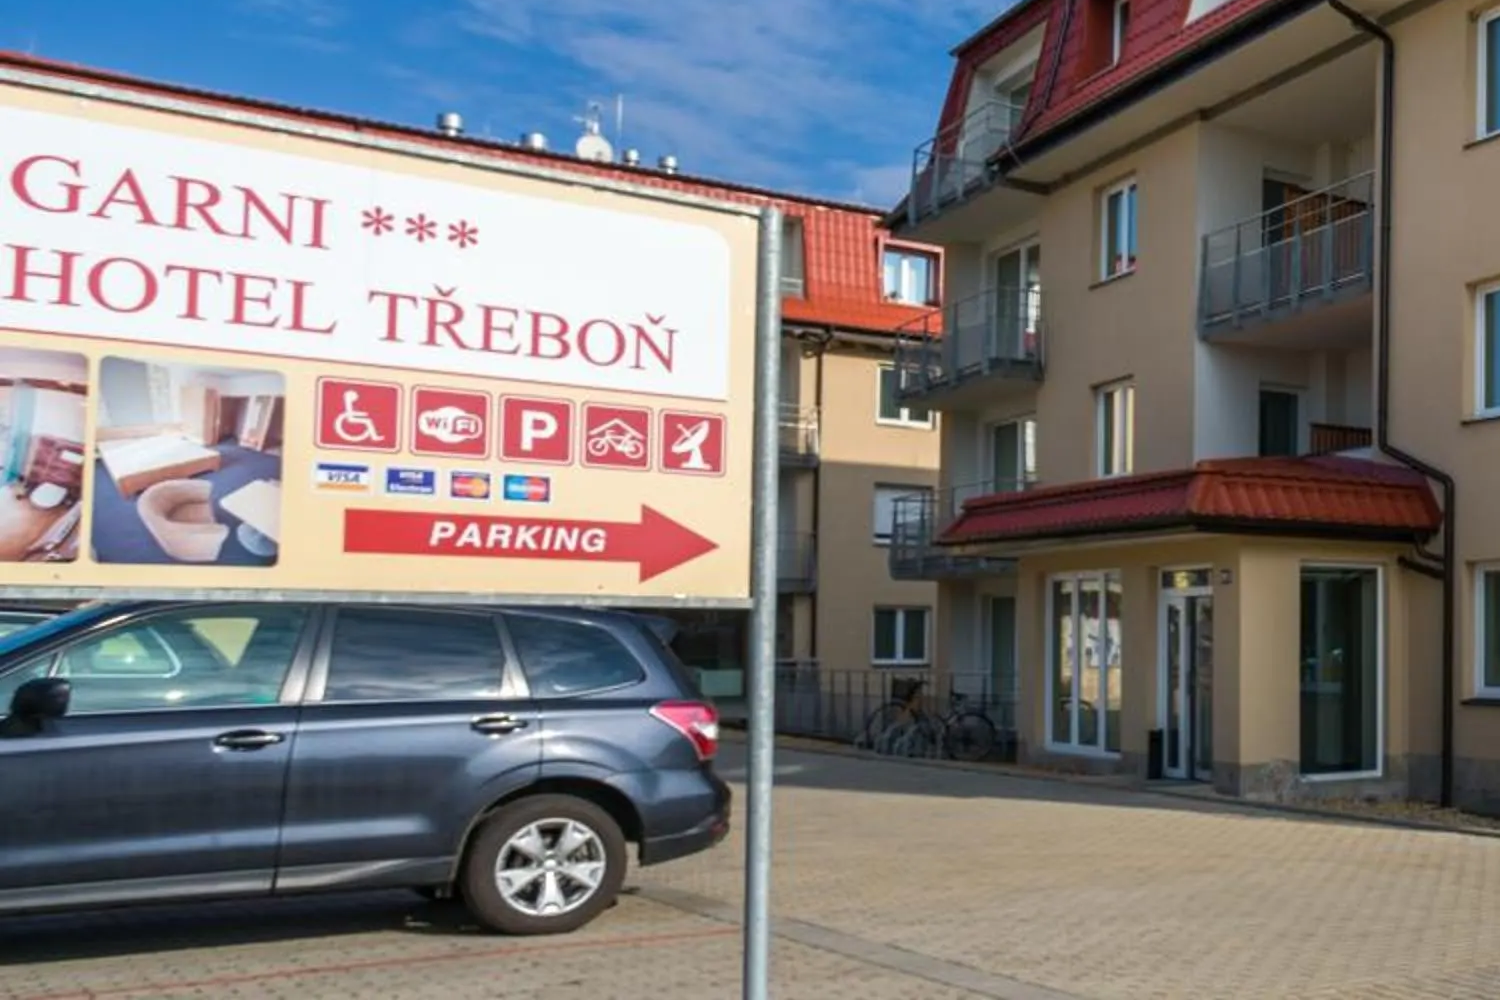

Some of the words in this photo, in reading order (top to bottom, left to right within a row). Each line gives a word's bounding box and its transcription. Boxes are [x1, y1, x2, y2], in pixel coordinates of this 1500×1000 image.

[10, 155, 333, 250] GARNI
[1, 243, 338, 334] HOTEL
[368, 284, 679, 373] TŘEBOŇ
[521, 409, 558, 451] P
[328, 472, 360, 483] VISA
[429, 521, 607, 552] PARKING
